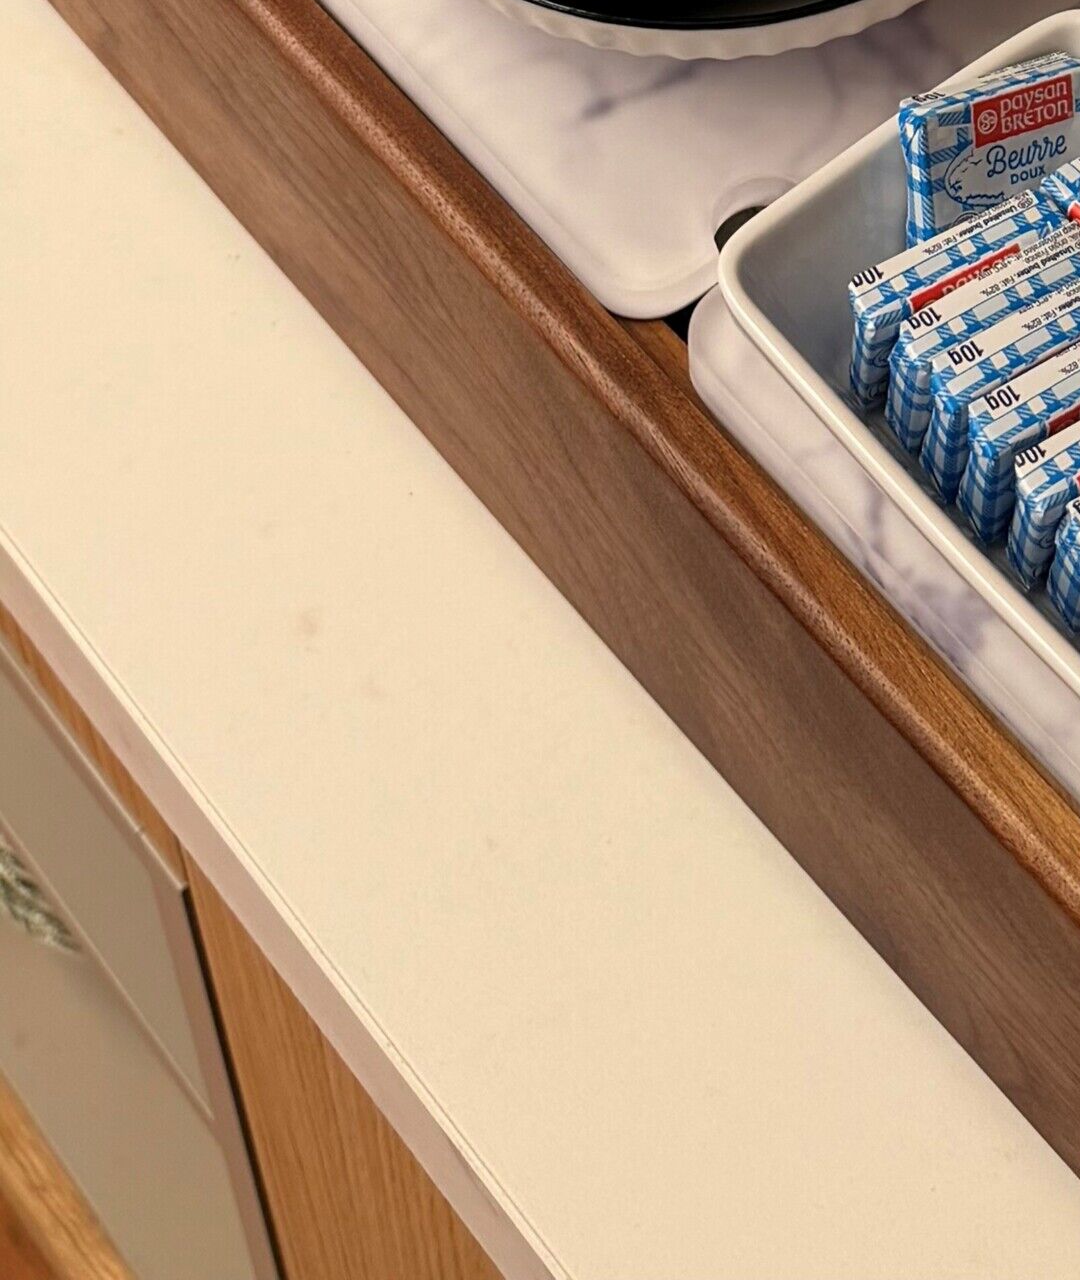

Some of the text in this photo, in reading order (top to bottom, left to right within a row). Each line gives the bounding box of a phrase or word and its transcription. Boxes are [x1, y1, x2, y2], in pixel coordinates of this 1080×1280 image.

[1000, 80, 1068, 116] paysan
[1002, 99, 1069, 134] BRETON
[987, 134, 1067, 178] Beurre
[1010, 164, 1046, 185] DOUX
[982, 205, 1017, 226] Unsalted
[955, 221, 983, 238] butter.
[1040, 245, 1074, 266] Unsalted
[1013, 262, 1040, 278] butter.
[1001, 275, 1015, 287] Fat:
[906, 307, 942, 330] 10g
[1040, 309, 1057, 321] Fat:
[946, 340, 984, 366] 10g
[981, 379, 1021, 411] 10g
